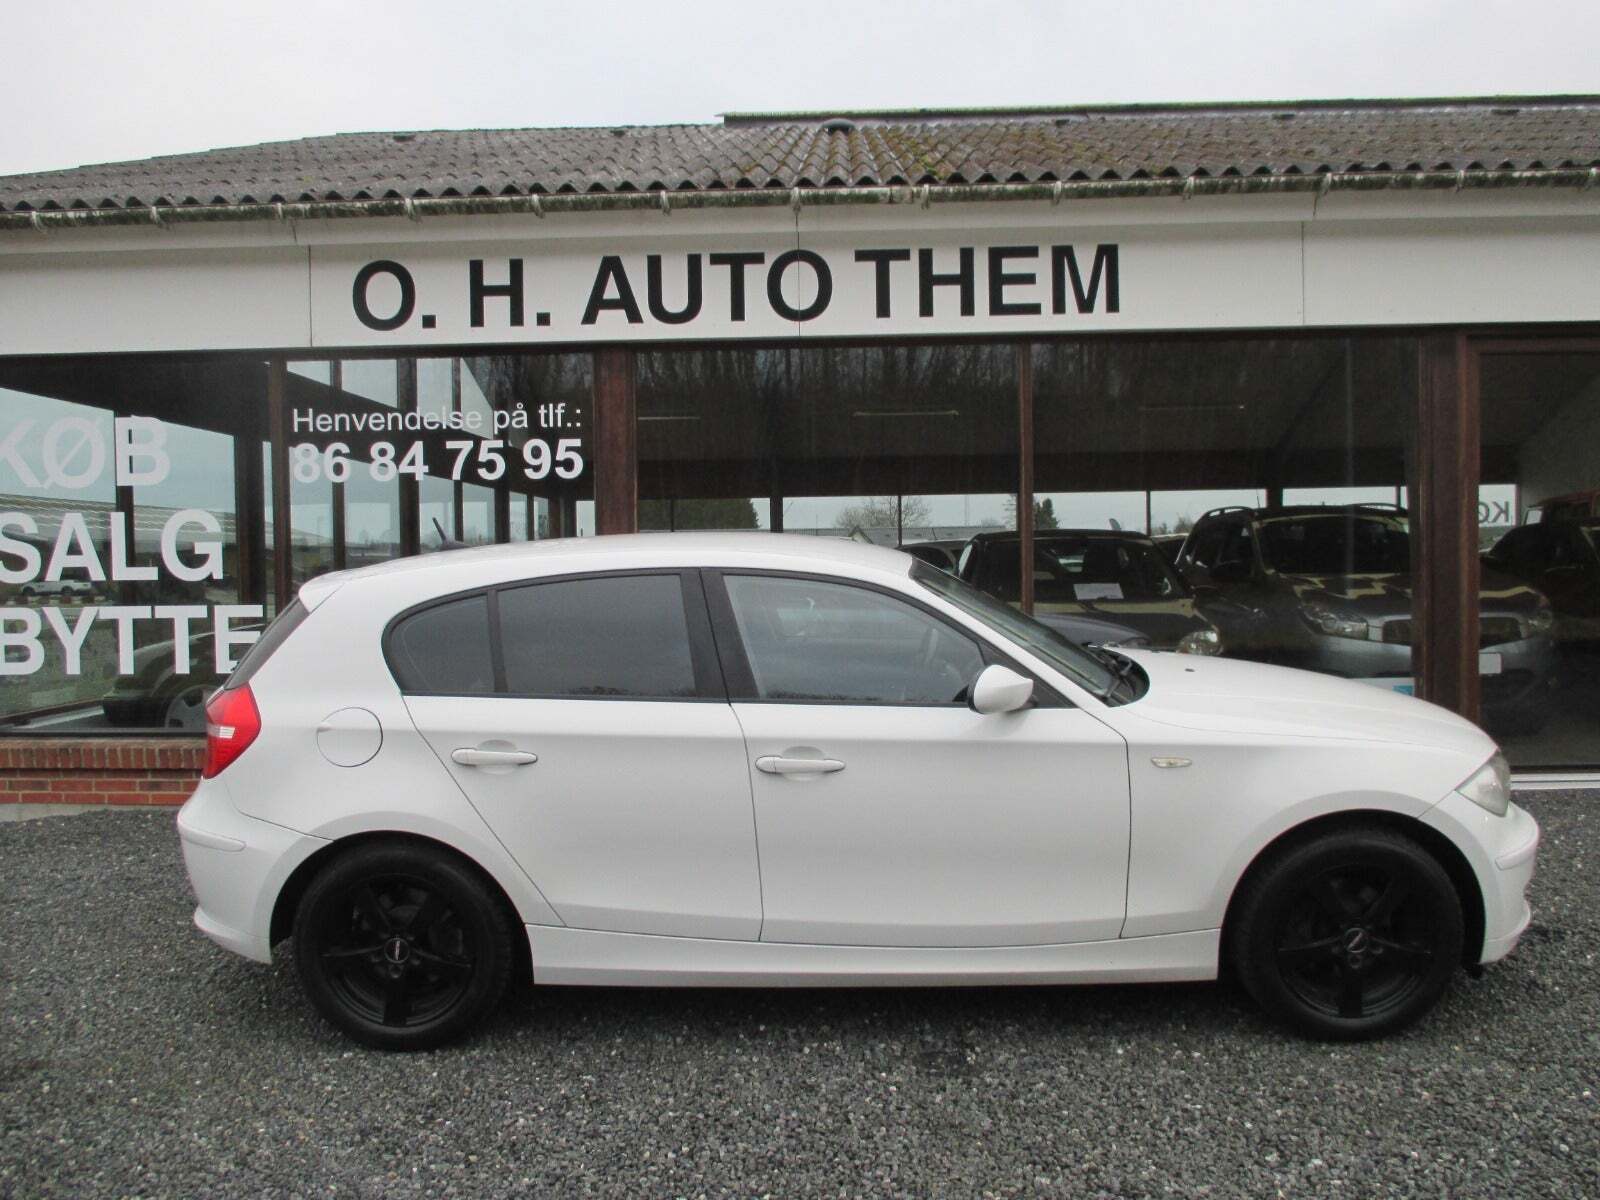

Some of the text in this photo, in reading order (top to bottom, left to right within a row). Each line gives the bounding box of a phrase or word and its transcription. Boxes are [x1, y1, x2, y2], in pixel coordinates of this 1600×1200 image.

[352, 243, 1120, 331] O. H. AUTO THEM
[0, 415, 171, 489] KØB
[292, 402, 582, 435] Henvendelse på tlf.:
[293, 438, 584, 484] 86 84 75 95
[0, 508, 225, 584] SALG
[0, 604, 264, 675] BYTTE
